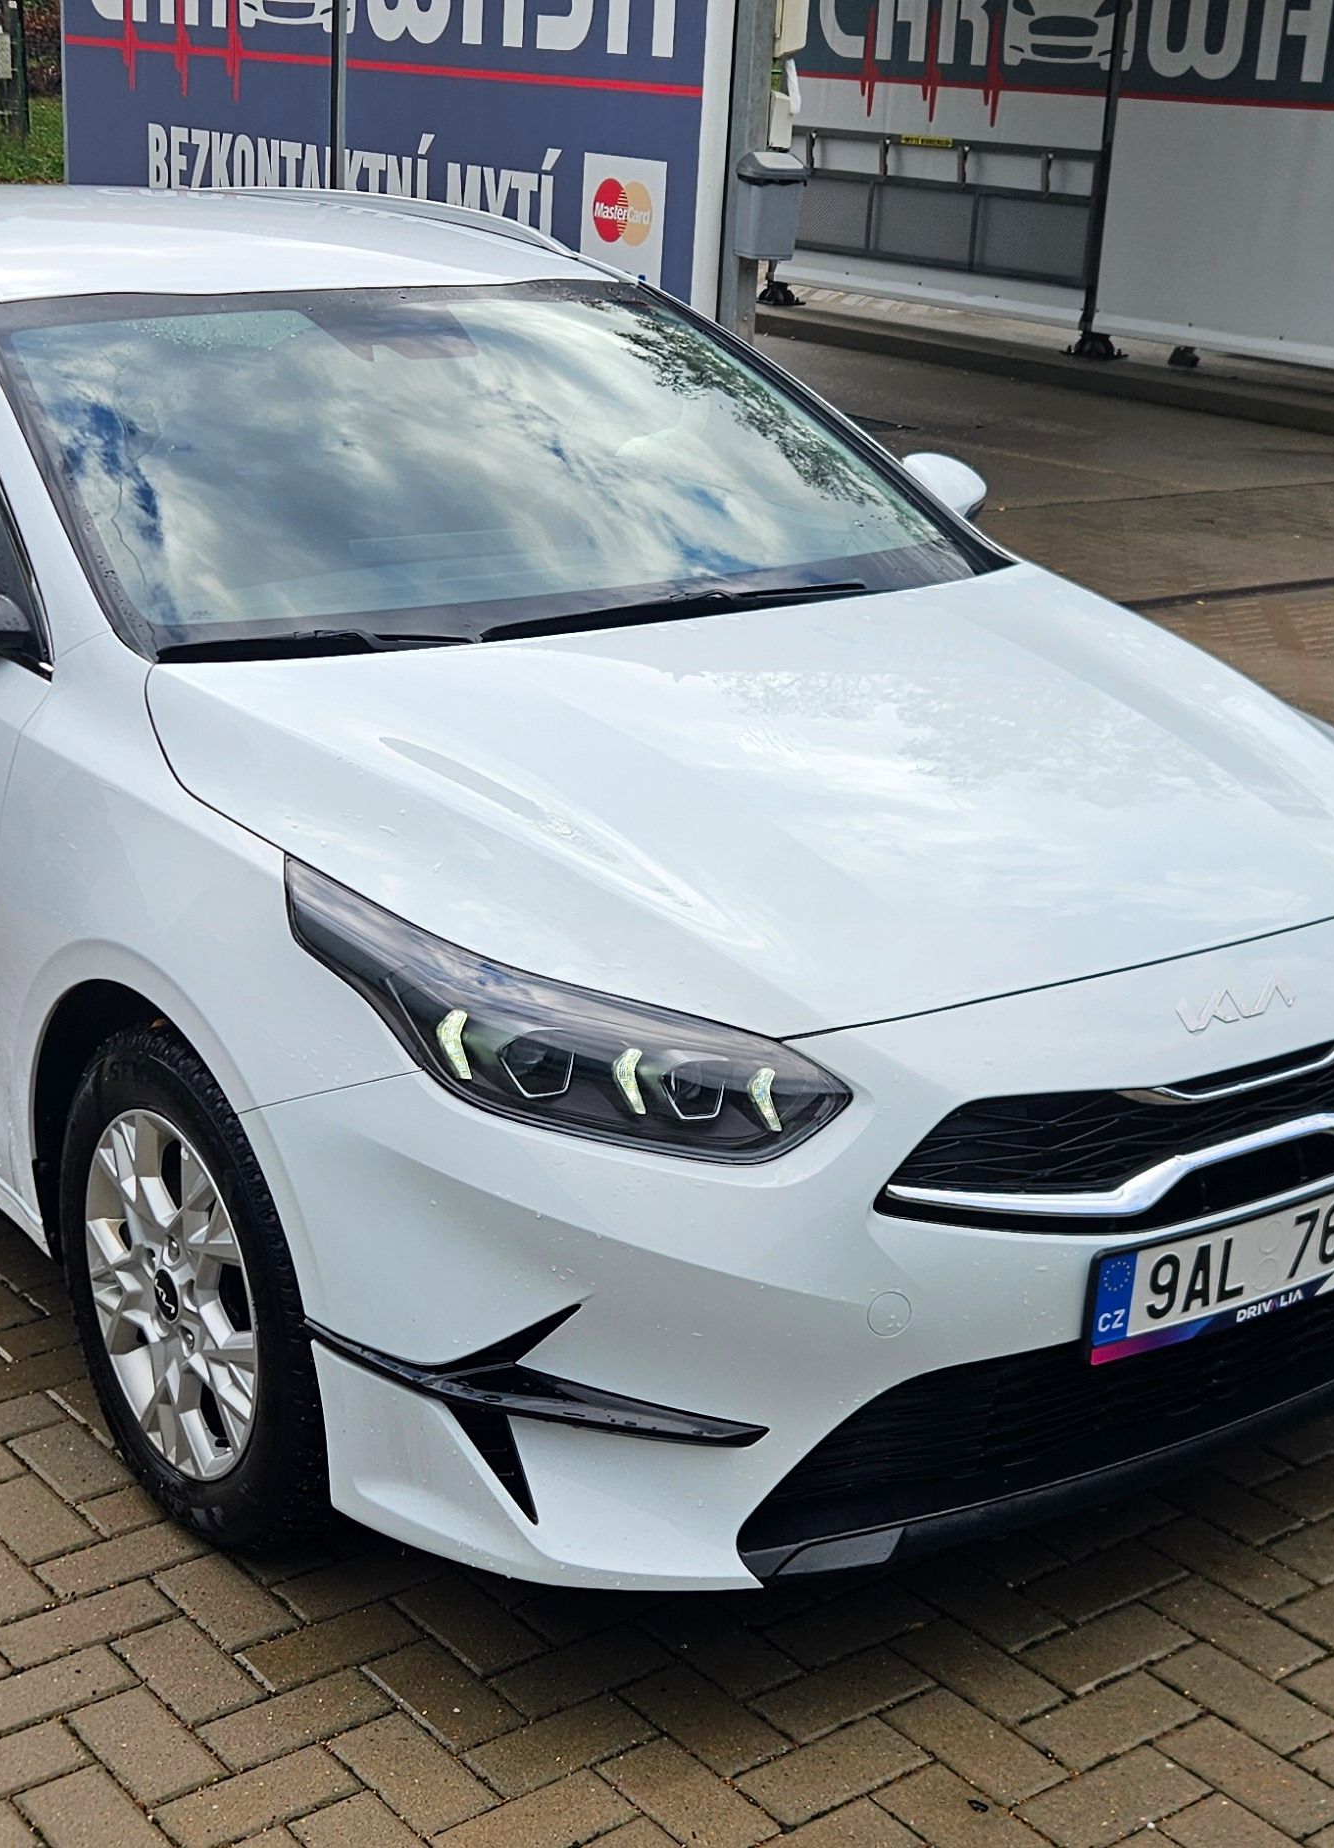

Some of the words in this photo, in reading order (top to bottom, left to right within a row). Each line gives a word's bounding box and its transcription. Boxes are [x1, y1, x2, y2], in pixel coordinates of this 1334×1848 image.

[148, 123, 435, 200] BEZKONTAKTNÍ
[446, 148, 562, 238] MYTÍ
[594, 202, 651, 224] MasterCard
[1145, 1237, 1244, 1320] 9AL
[1097, 1307, 1125, 1332] CZ
[1236, 1288, 1305, 1323] DRIVALIA
